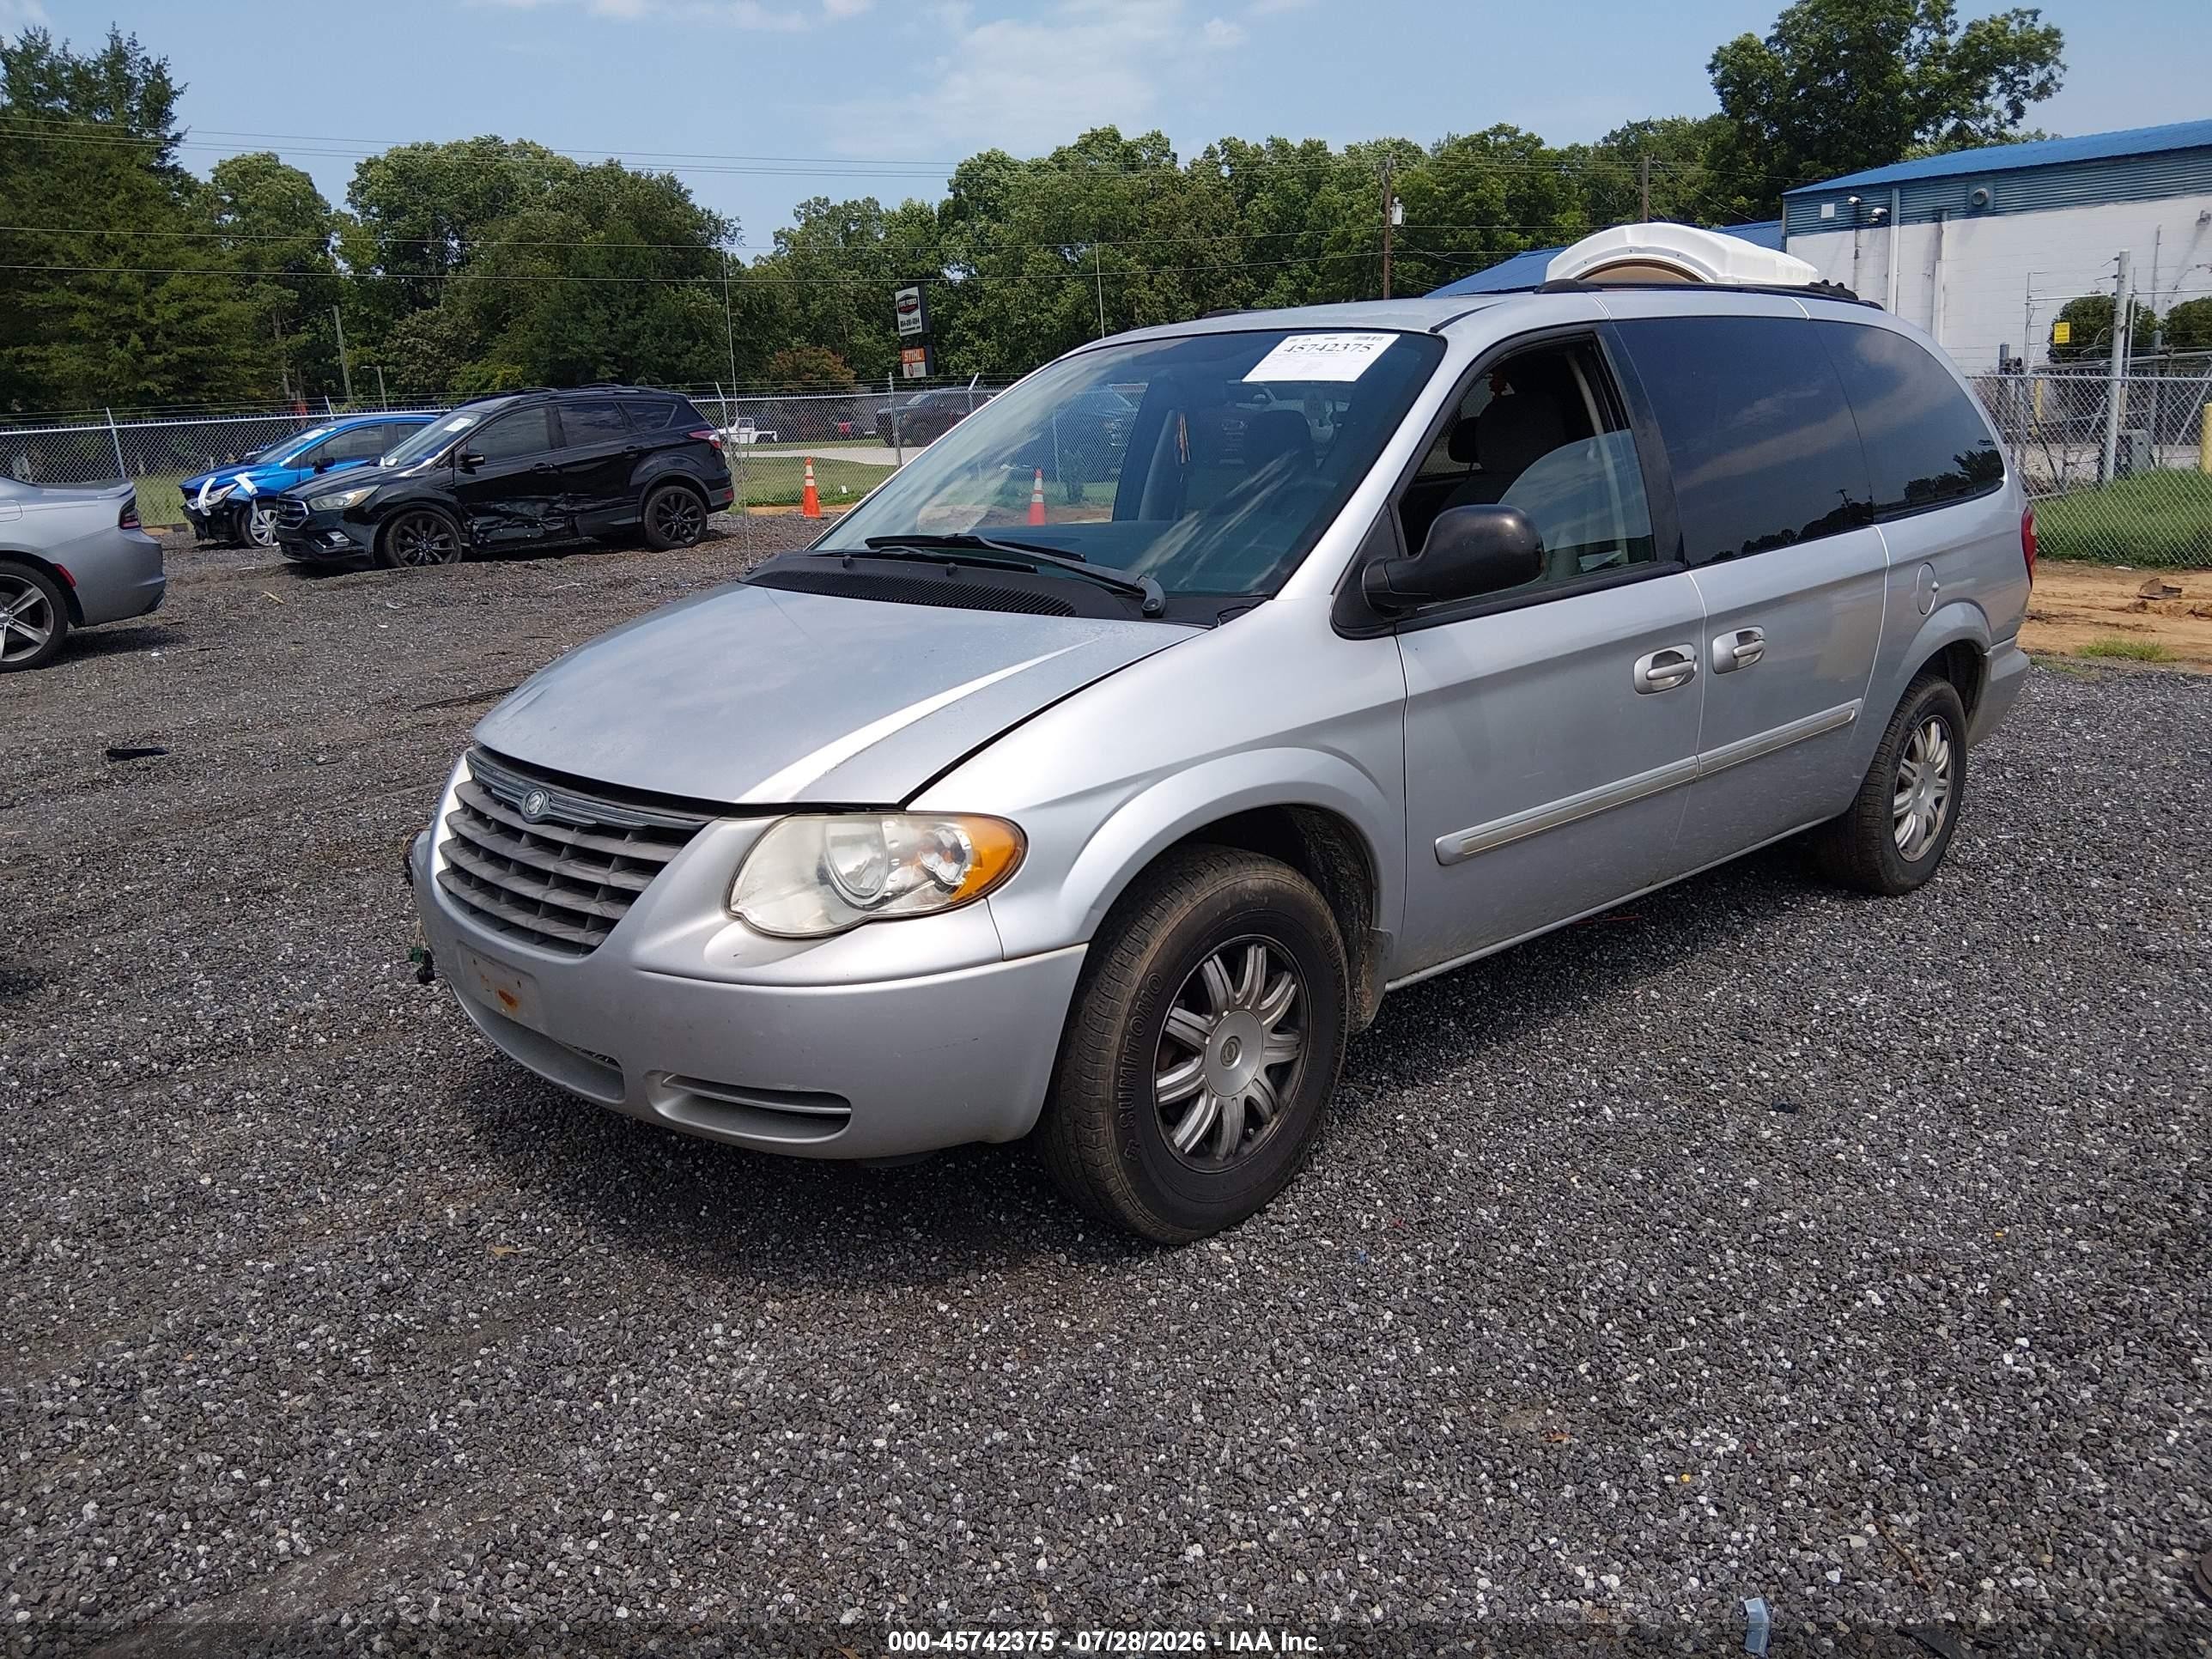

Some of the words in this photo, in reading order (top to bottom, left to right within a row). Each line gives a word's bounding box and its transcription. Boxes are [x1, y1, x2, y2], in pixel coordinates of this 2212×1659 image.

[1283, 343, 1375, 354] 45742375
[904, 350, 922, 362] STIHL
[1119, 972, 1163, 1128] SUMITOMO
